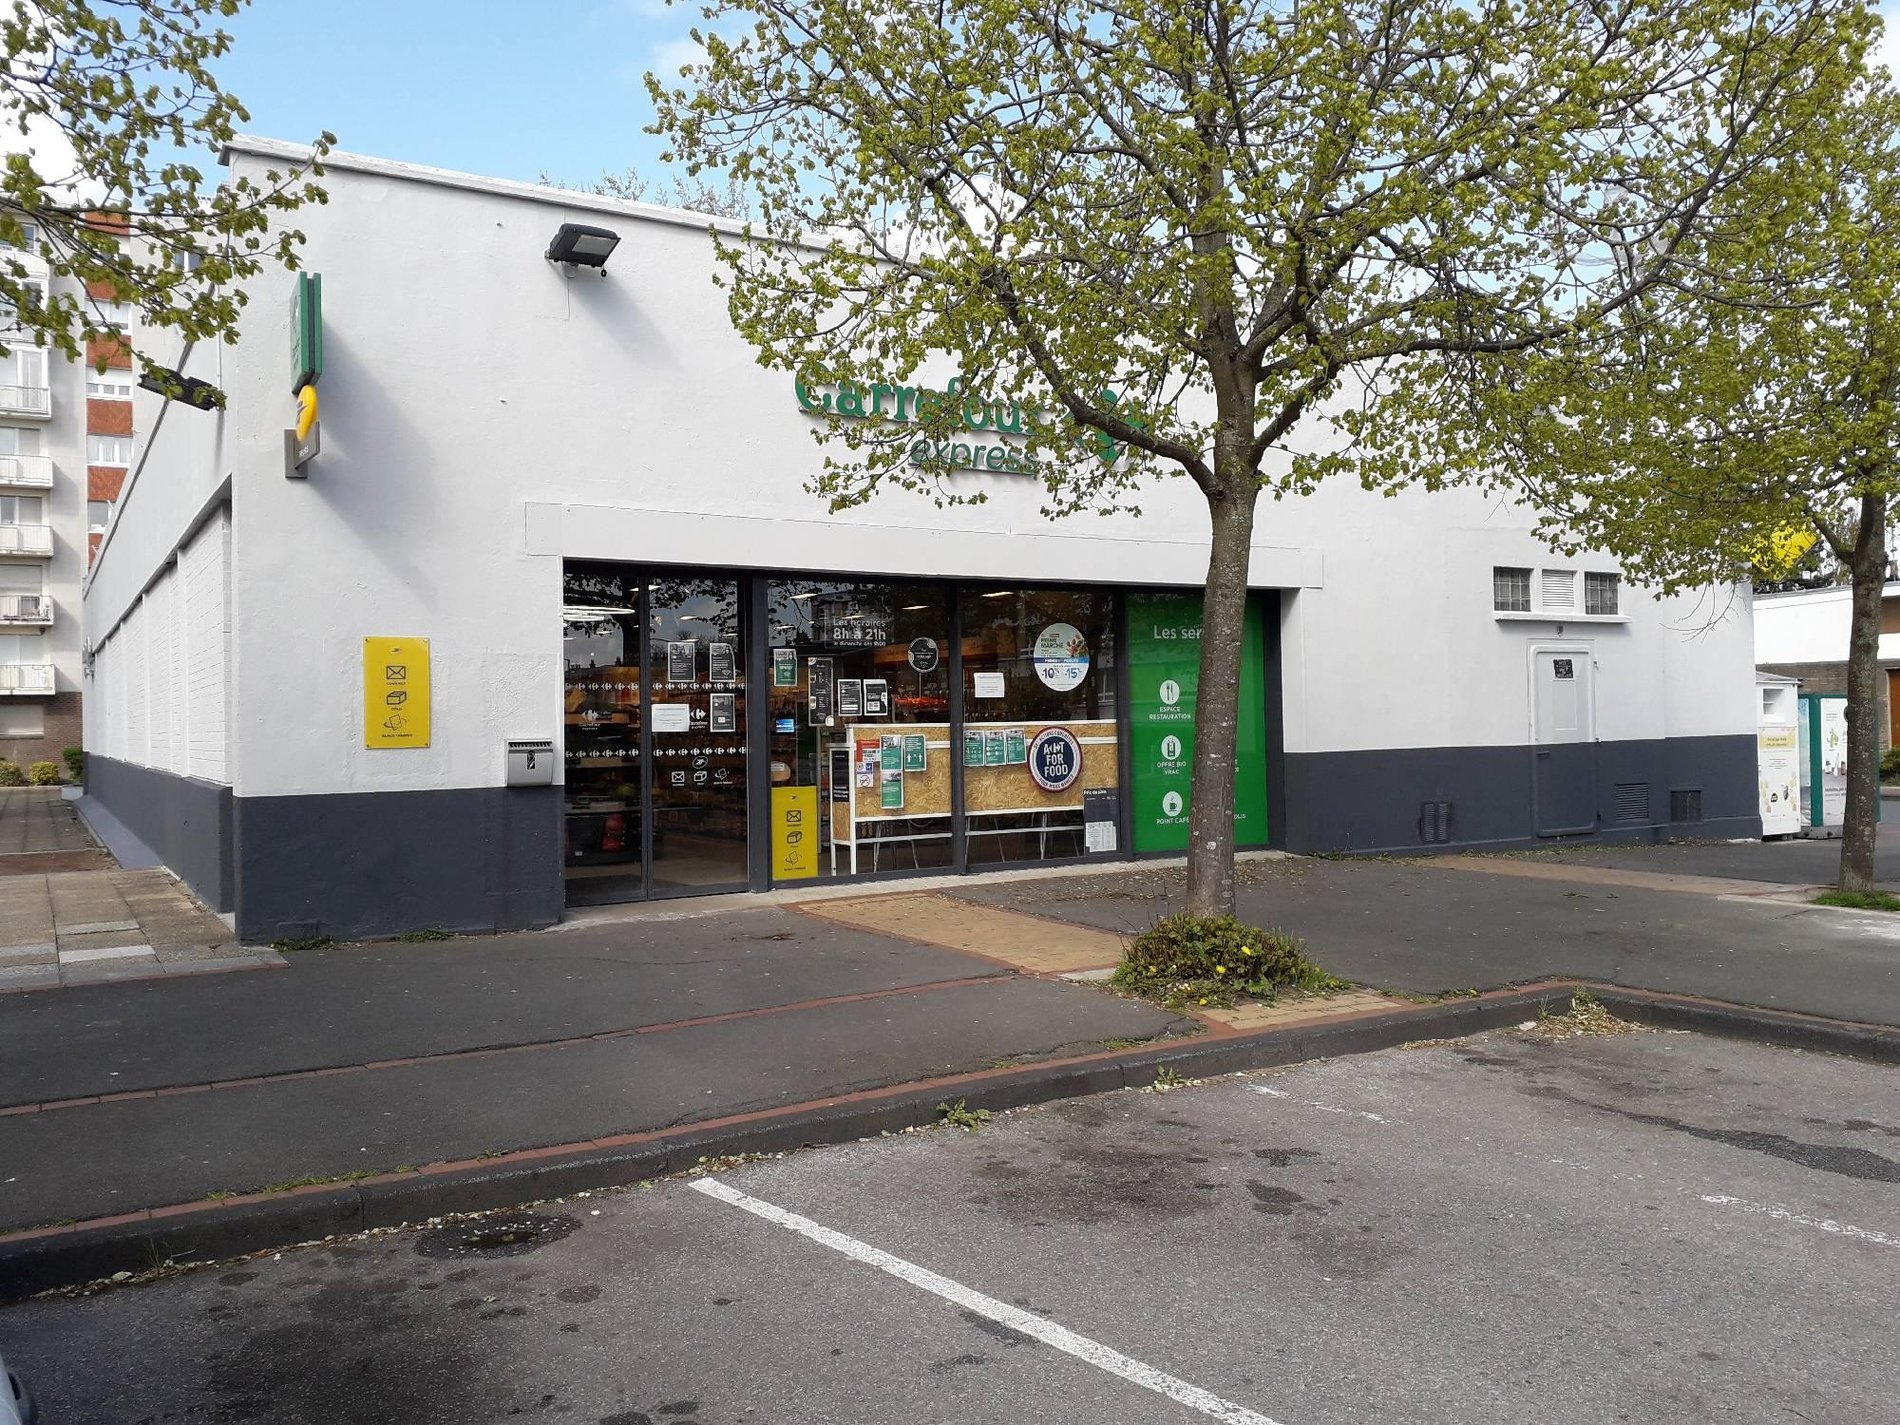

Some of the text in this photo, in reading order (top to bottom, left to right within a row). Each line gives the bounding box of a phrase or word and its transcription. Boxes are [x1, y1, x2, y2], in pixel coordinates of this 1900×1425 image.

[794, 362, 1047, 435] Carrefou
[909, 438, 1039, 474] express
[833, 618, 886, 627] Les horaires
[833, 627, 849, 640] 8h
[865, 628, 887, 640] 21h
[1153, 624, 1203, 640] Les ser
[1045, 753, 1064, 766] FOR
[1044, 764, 1069, 778] FOOD
